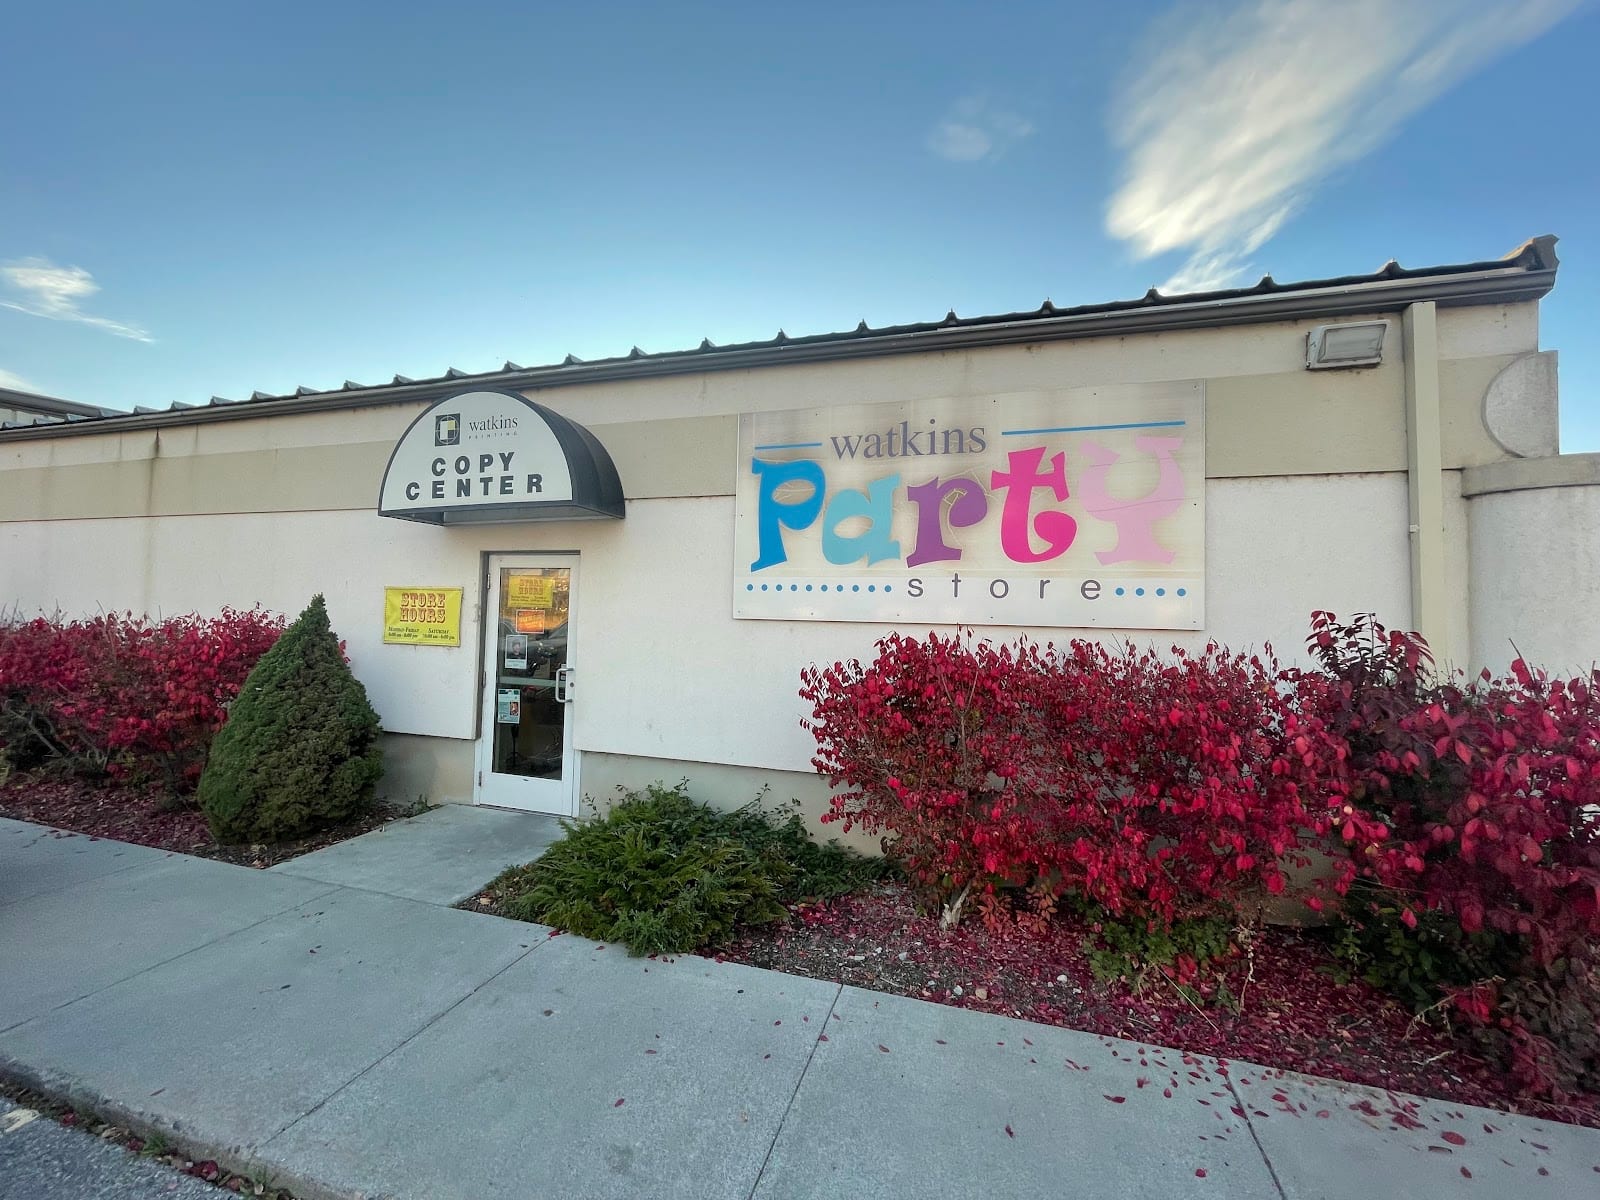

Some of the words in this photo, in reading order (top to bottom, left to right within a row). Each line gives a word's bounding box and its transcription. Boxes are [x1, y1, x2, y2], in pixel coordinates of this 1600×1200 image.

[468, 414, 518, 432] watkins
[830, 418, 988, 461] watkins
[431, 452, 515, 477] COPY
[405, 473, 543, 501] CENTER
[906, 573, 1102, 600] store
[401, 592, 446, 608] STORE
[399, 607, 446, 623] HOURS
